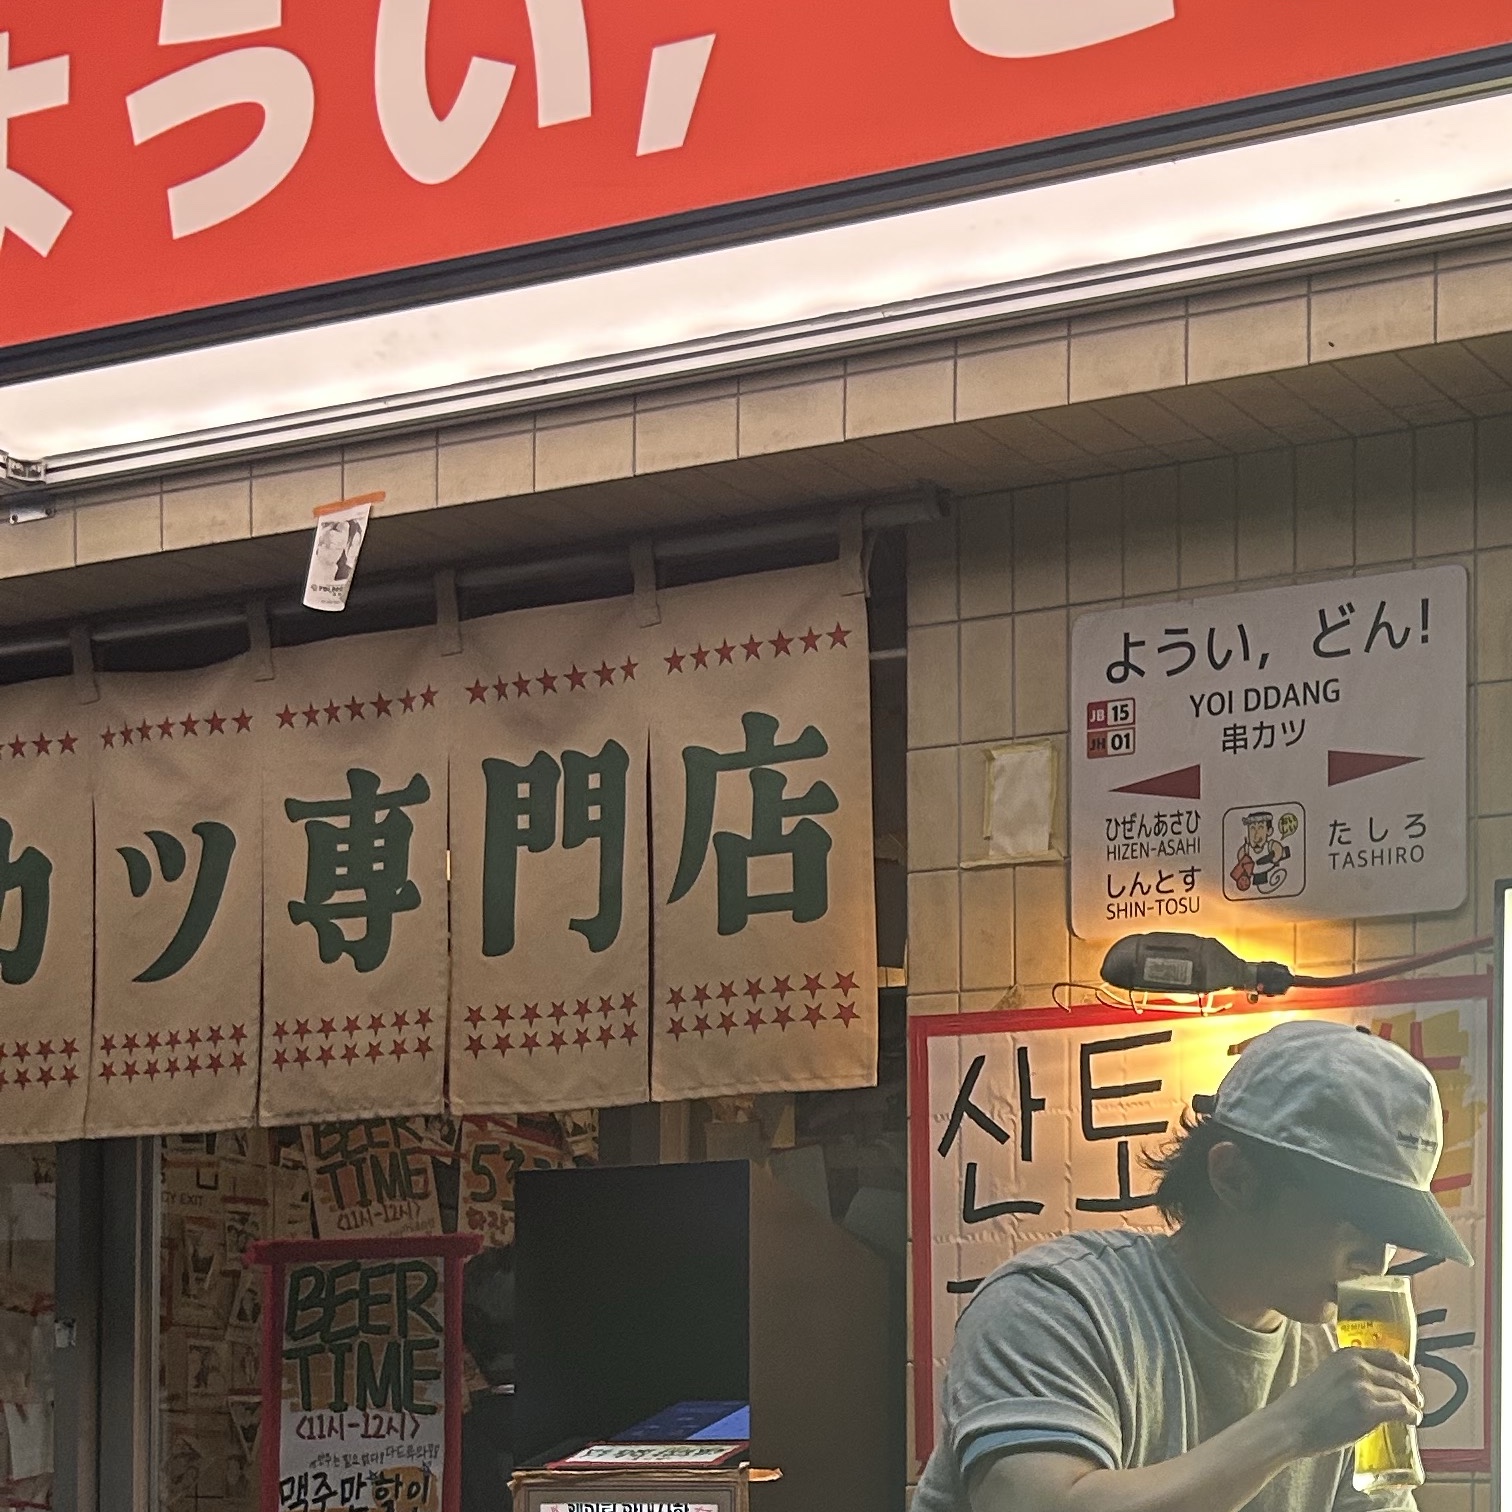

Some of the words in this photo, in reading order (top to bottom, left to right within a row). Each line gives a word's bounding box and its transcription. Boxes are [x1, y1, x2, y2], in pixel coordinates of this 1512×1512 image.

[1312, 598, 1430, 658] どん!
[1112, 704, 1129, 722] 15
[1189, 690, 1234, 718] YOI
[1244, 679, 1341, 713] DDANG
[1111, 732, 1131, 751] 01
[1221, 718, 1307, 755] 串カツ
[1106, 809, 1201, 841] ひぜんあさひ
[1328, 813, 1428, 848] たしろ
[1107, 836, 1201, 862] HIZEN-ASAHI
[1328, 844, 1426, 871] TASHIRO
[1107, 865, 1202, 899] しんとす
[1106, 895, 1200, 920] SHIN-TOSU
[938, 1029, 1178, 1224] 산토
[315, 1147, 431, 1211] TIME
[287, 1258, 443, 1344] BEER
[281, 1338, 441, 1415] TIME
